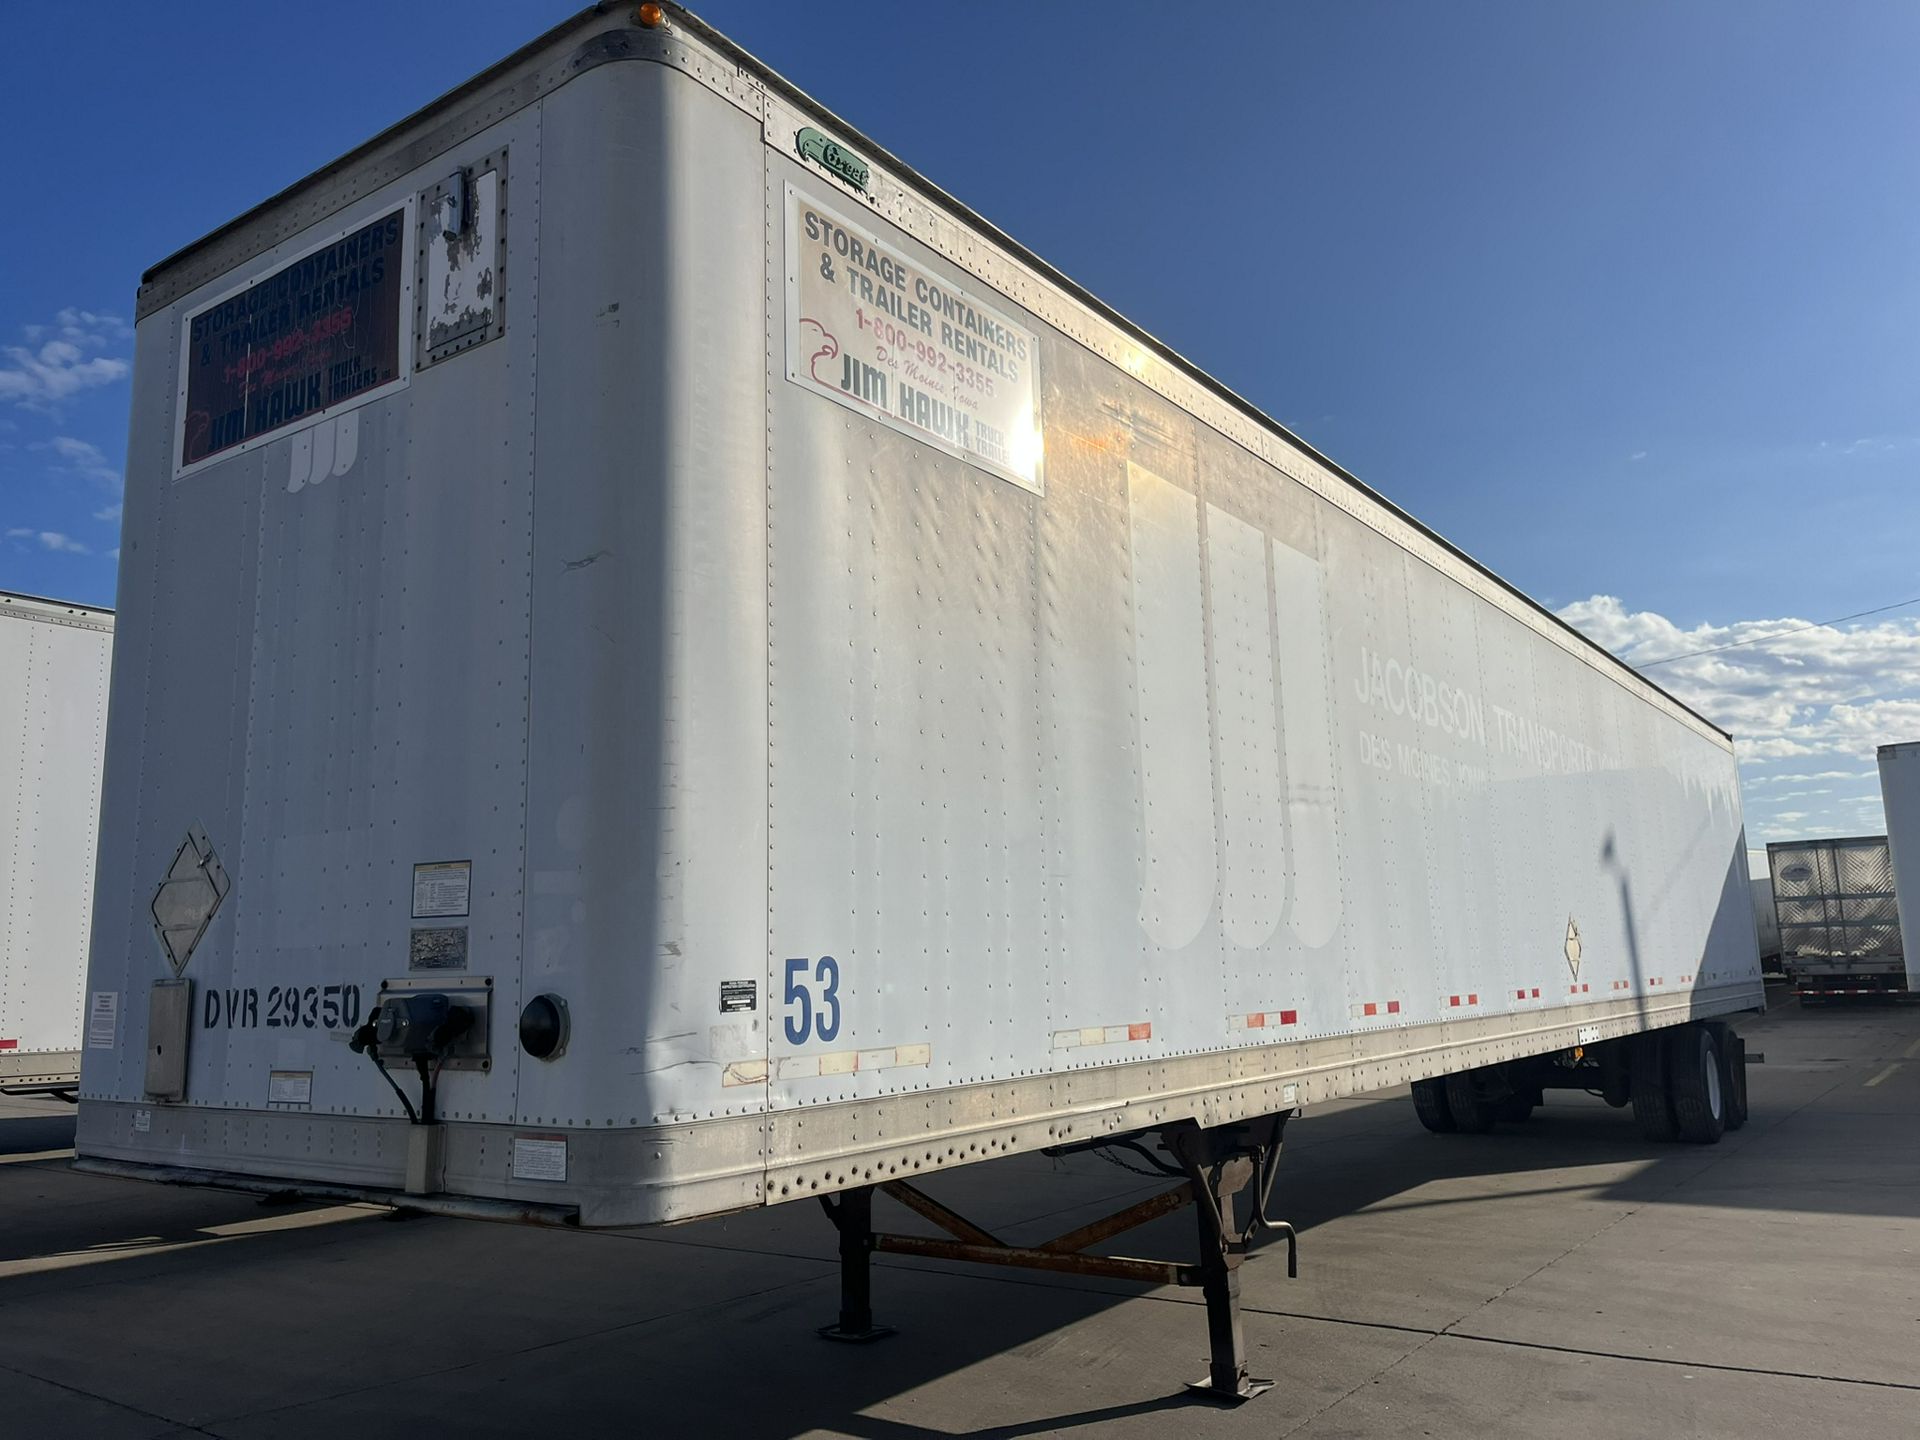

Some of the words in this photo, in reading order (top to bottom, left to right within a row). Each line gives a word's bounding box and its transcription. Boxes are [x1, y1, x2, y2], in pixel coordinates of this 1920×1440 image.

[192, 285, 273, 342] STORAGE
[276, 218, 399, 296] CONTAINERS
[297, 257, 385, 318] RENTALS
[804, 211, 907, 292] STORAGE
[915, 278, 1027, 362] CONTAINERS
[820, 253, 836, 284] &
[846, 266, 932, 337] TRAILER
[941, 322, 1019, 384] RENTALS
[854, 308, 994, 398] 1-800-992-3355
[255, 373, 322, 433] HAWK
[841, 353, 887, 410] JIM
[899, 383, 970, 450] HAWK
[1354, 646, 1486, 747] JACOBSON
[1360, 730, 1392, 771] DES
[204, 988, 259, 1029] DVR
[266, 984, 361, 1030] 29350
[784, 956, 842, 1046] 53
